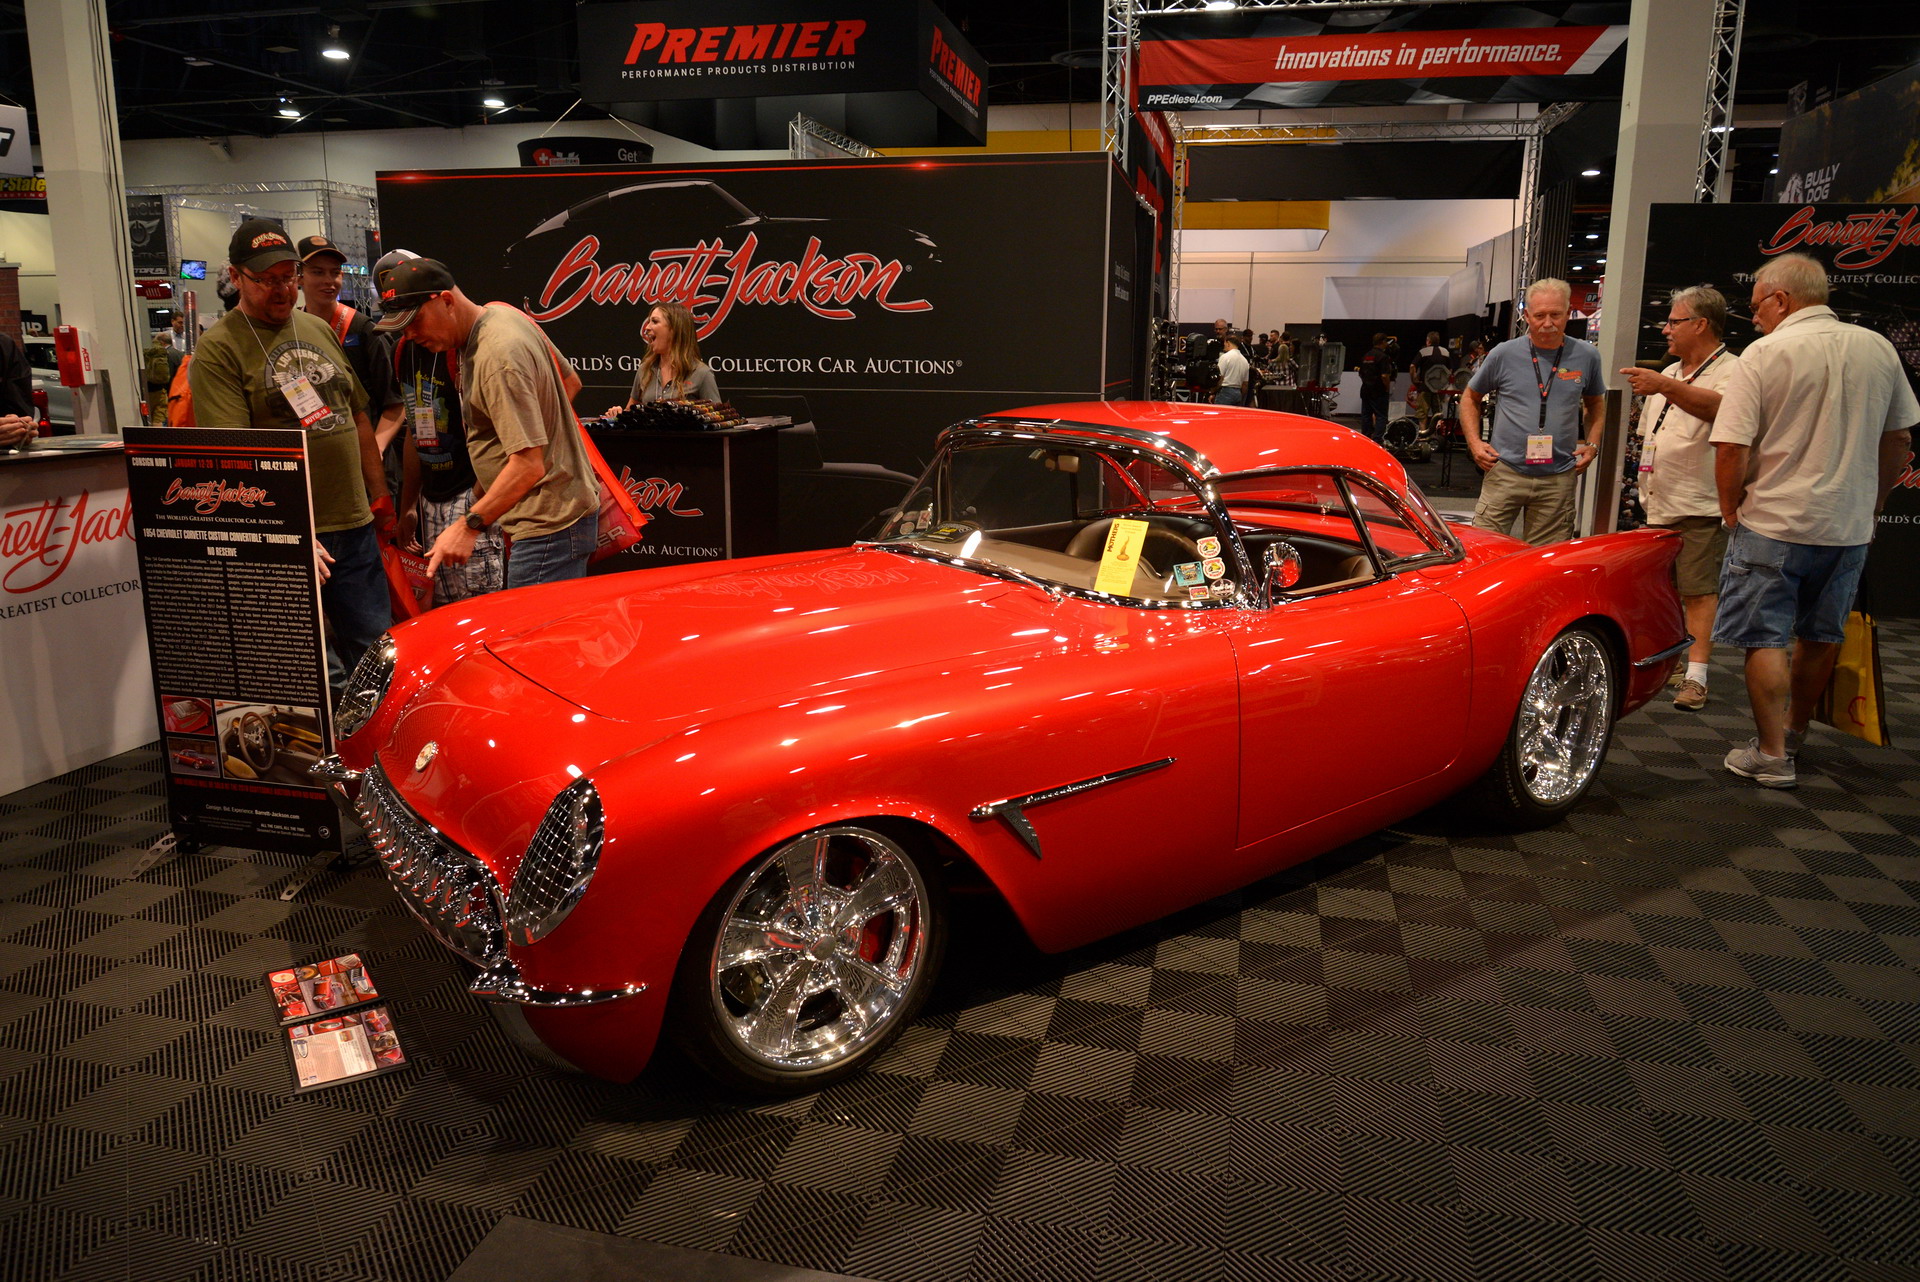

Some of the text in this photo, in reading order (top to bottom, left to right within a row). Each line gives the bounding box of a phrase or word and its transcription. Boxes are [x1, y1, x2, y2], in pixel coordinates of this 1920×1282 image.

[624, 19, 866, 64] PREMIER
[1275, 38, 1562, 71] Innovations in performance.
[622, 60, 855, 79] PERFORMANCE PRODUCTS DISTRIBUTION
[930, 23, 982, 106] PREMIER
[1147, 92, 1222, 105] PPEdiesel.com
[618, 148, 638, 163] Get
[1804, 162, 1840, 189] BULLY
[1806, 186, 1830, 203] DOG
[708, 356, 814, 373] COLLECTOR
[818, 357, 858, 374] CAR
[630, 543, 656, 555] CAR
[62, 580, 140, 606] COLLECTOR
